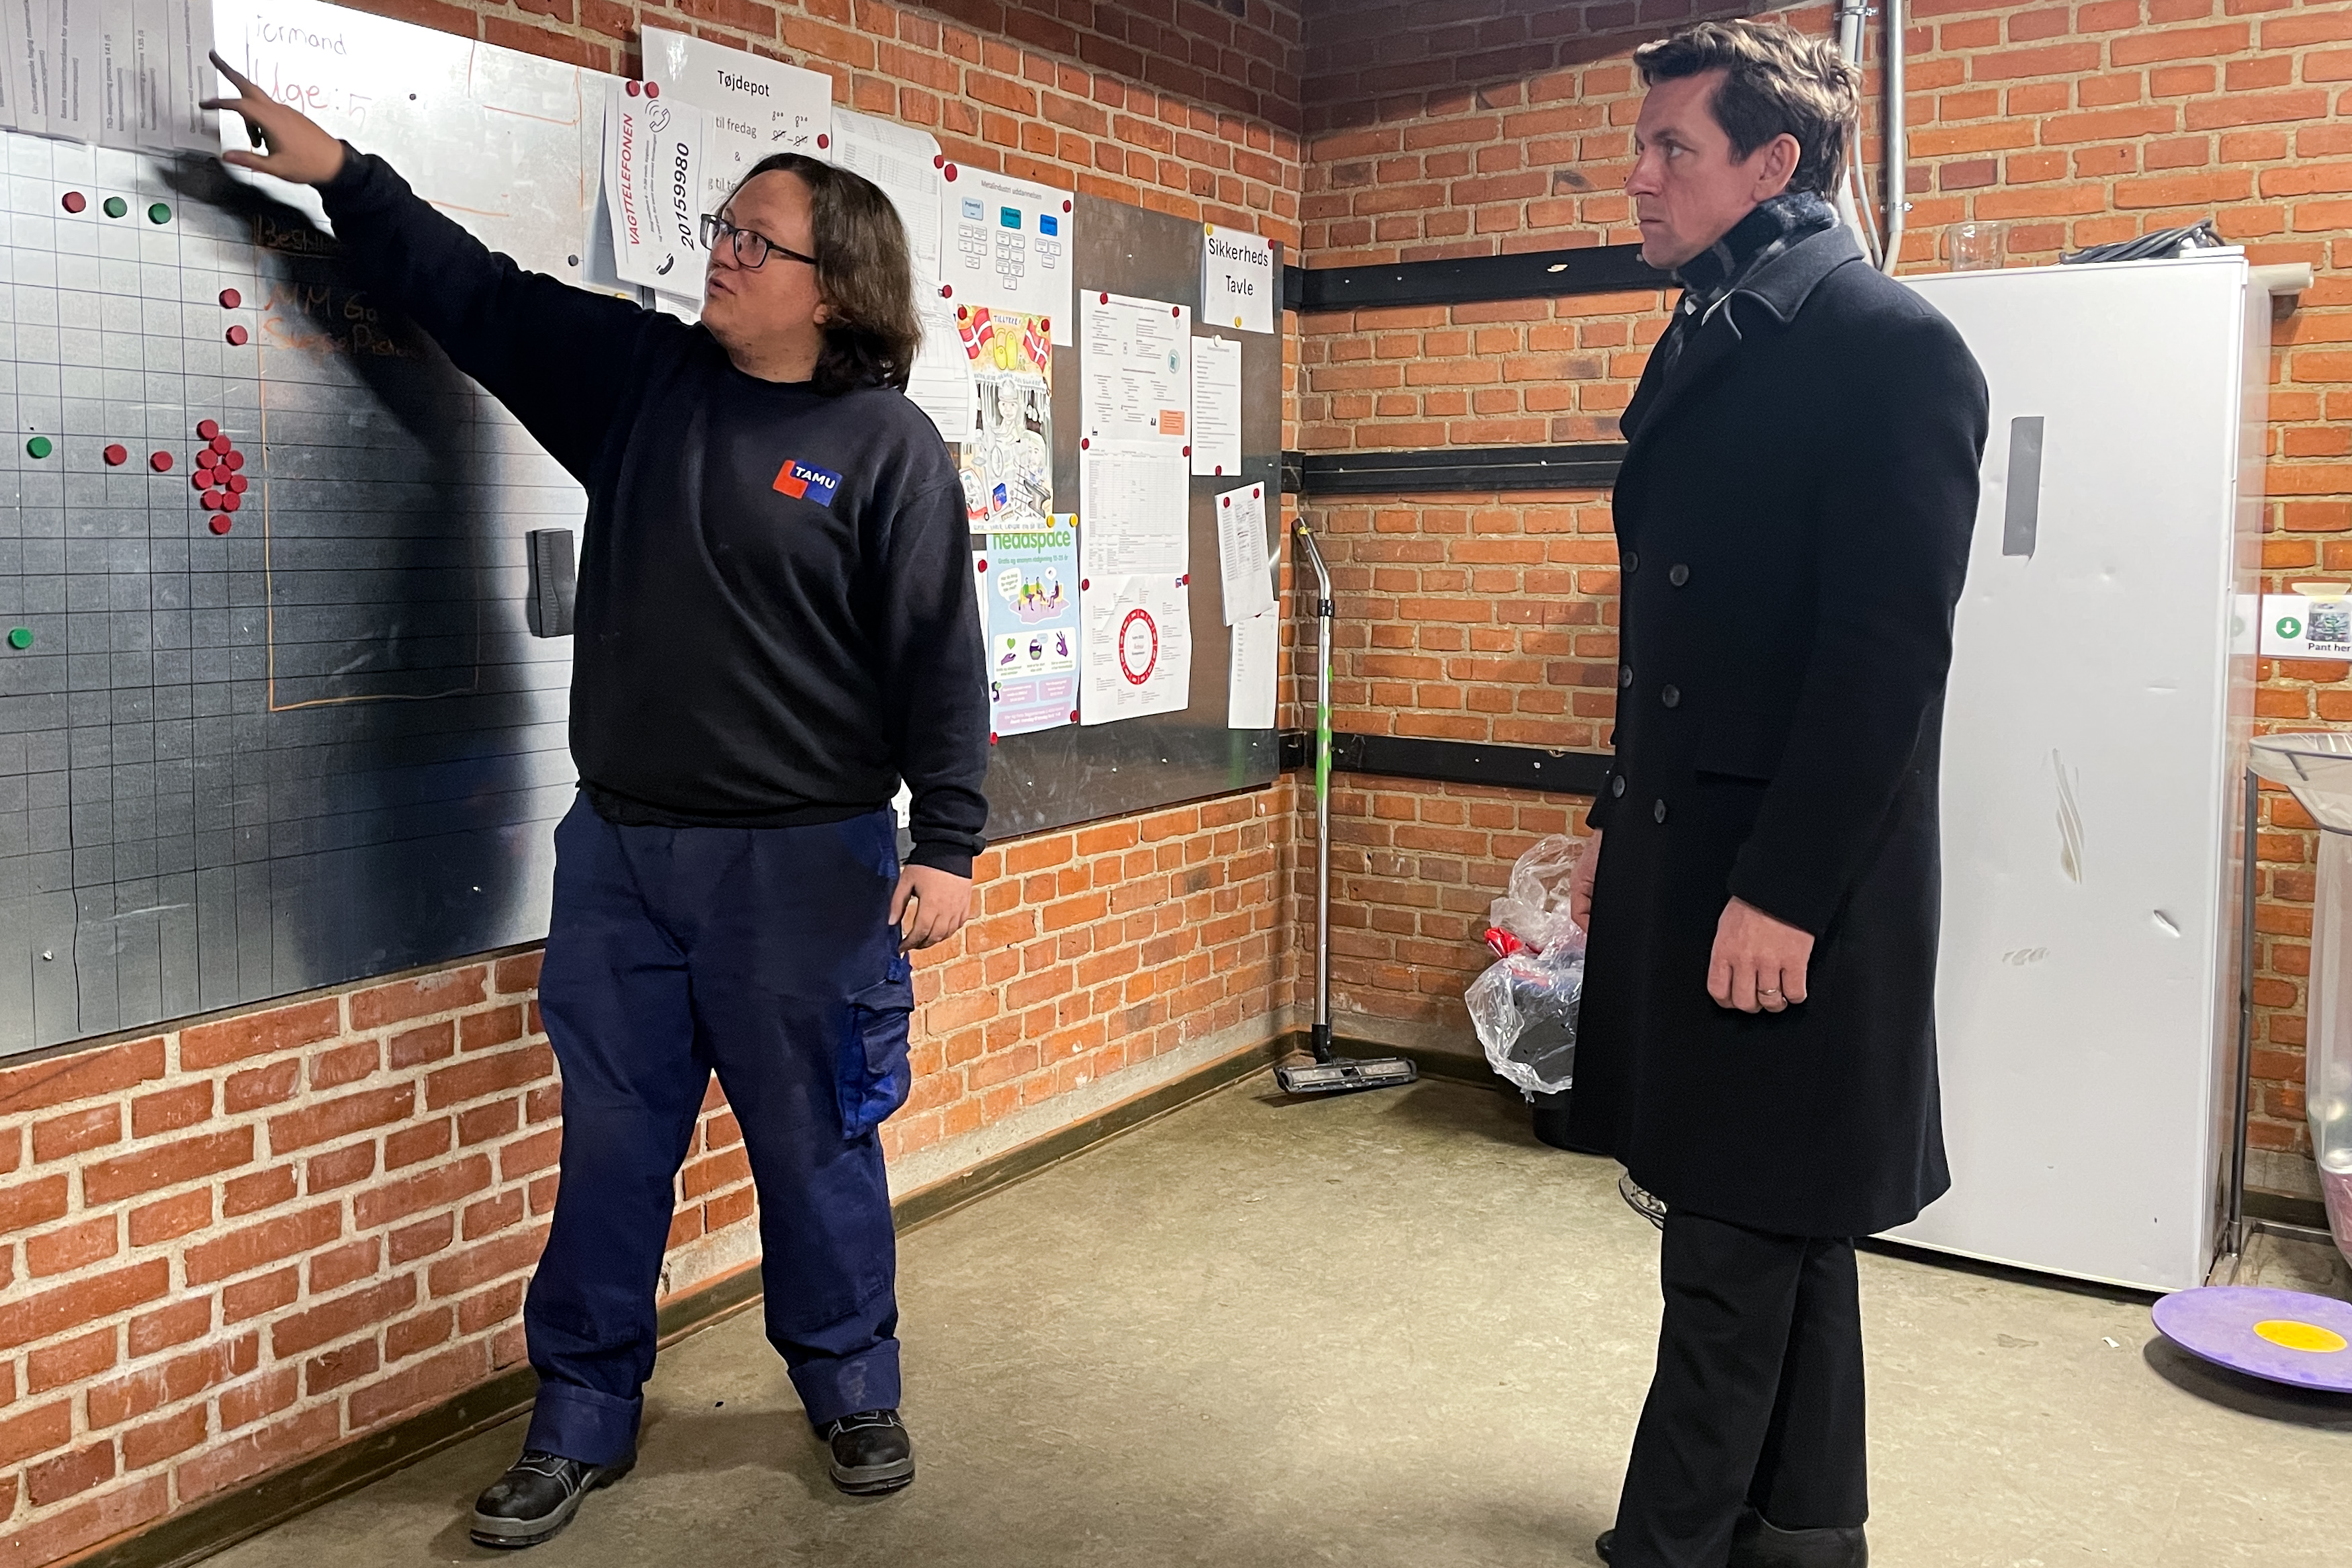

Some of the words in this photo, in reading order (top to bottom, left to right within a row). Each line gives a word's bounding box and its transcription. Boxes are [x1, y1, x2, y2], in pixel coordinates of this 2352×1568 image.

[717, 70, 769, 97] Tøjdepot
[716, 117, 725, 129] til
[728, 118, 757, 139] fredag
[735, 151, 741, 162] &
[621, 113, 640, 246] VAGTTELEFONEN
[672, 142, 695, 251] 20159980
[1209, 238, 1268, 266] Sikkerheds
[1226, 275, 1253, 296] Tavle
[993, 328, 1018, 370] 60
[795, 466, 836, 489] TAMU
[2308, 642, 2331, 652] Pant
[2335, 644, 2351, 652] her
